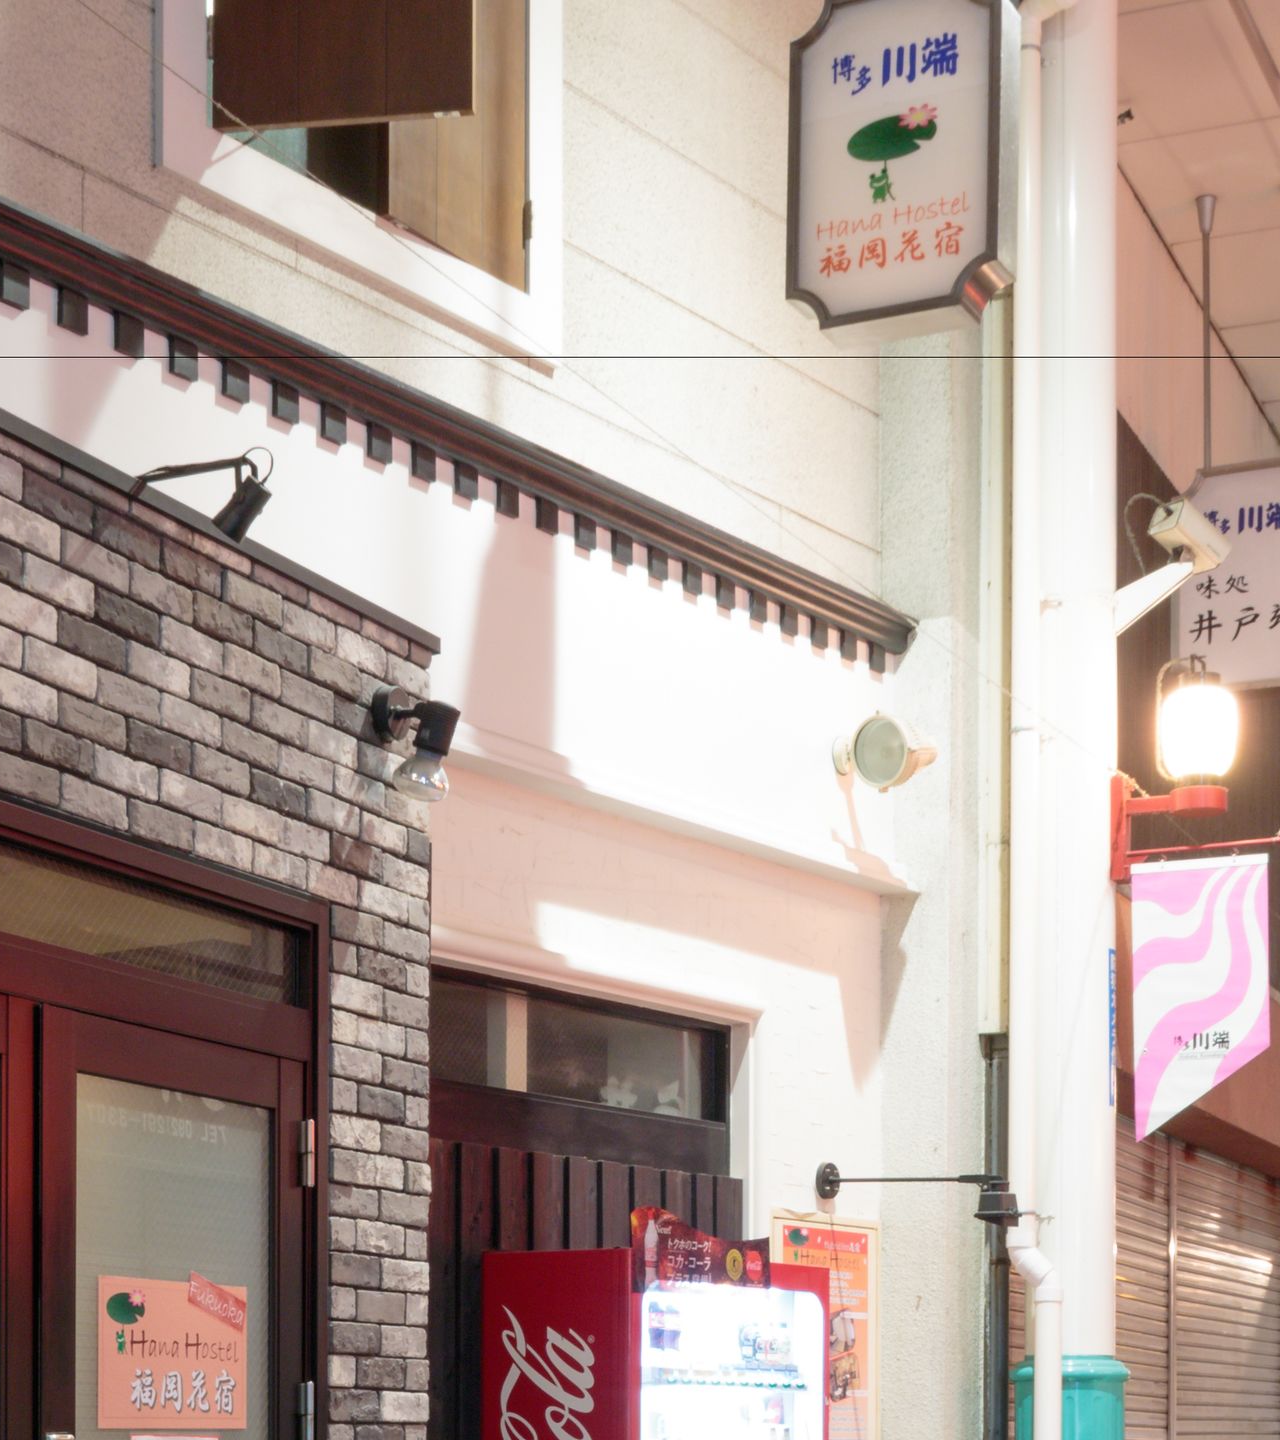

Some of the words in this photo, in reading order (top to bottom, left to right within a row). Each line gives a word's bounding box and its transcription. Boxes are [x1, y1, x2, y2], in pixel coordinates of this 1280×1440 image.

[831, 32, 959, 96] 博多川端
[816, 211, 882, 241] Hana
[893, 191, 970, 225] Hostel
[819, 221, 965, 279] 福岡花宿
[1196, 574, 1249, 599] 味処
[130, 1329, 180, 1358] Hana
[185, 1332, 239, 1363] Hostel
[130, 1368, 237, 1415] 福岡花宿
